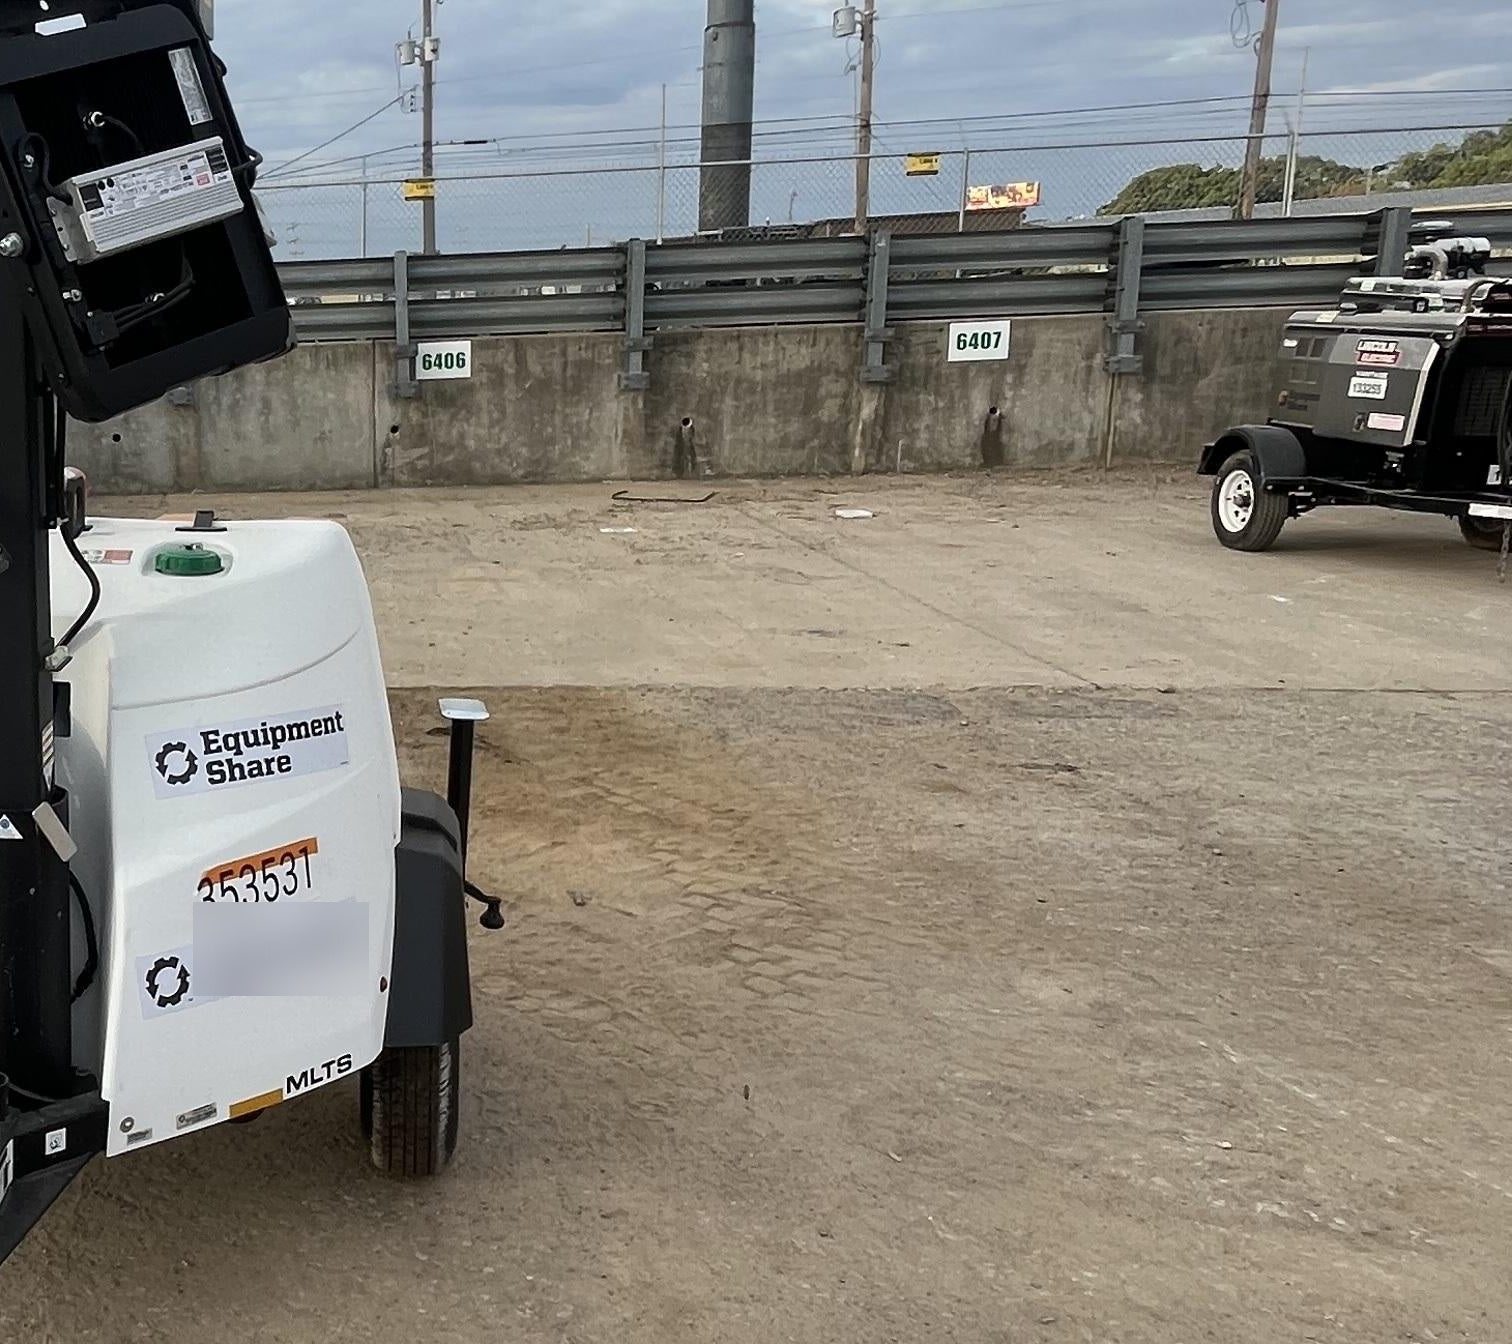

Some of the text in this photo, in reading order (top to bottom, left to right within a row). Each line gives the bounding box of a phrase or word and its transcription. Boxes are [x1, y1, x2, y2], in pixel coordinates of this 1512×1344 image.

[956, 331, 1002, 350] 6407
[422, 352, 466, 371] 6406
[199, 711, 345, 756] Equipment
[205, 754, 293, 785] Share
[286, 1053, 353, 1095] MLTS
